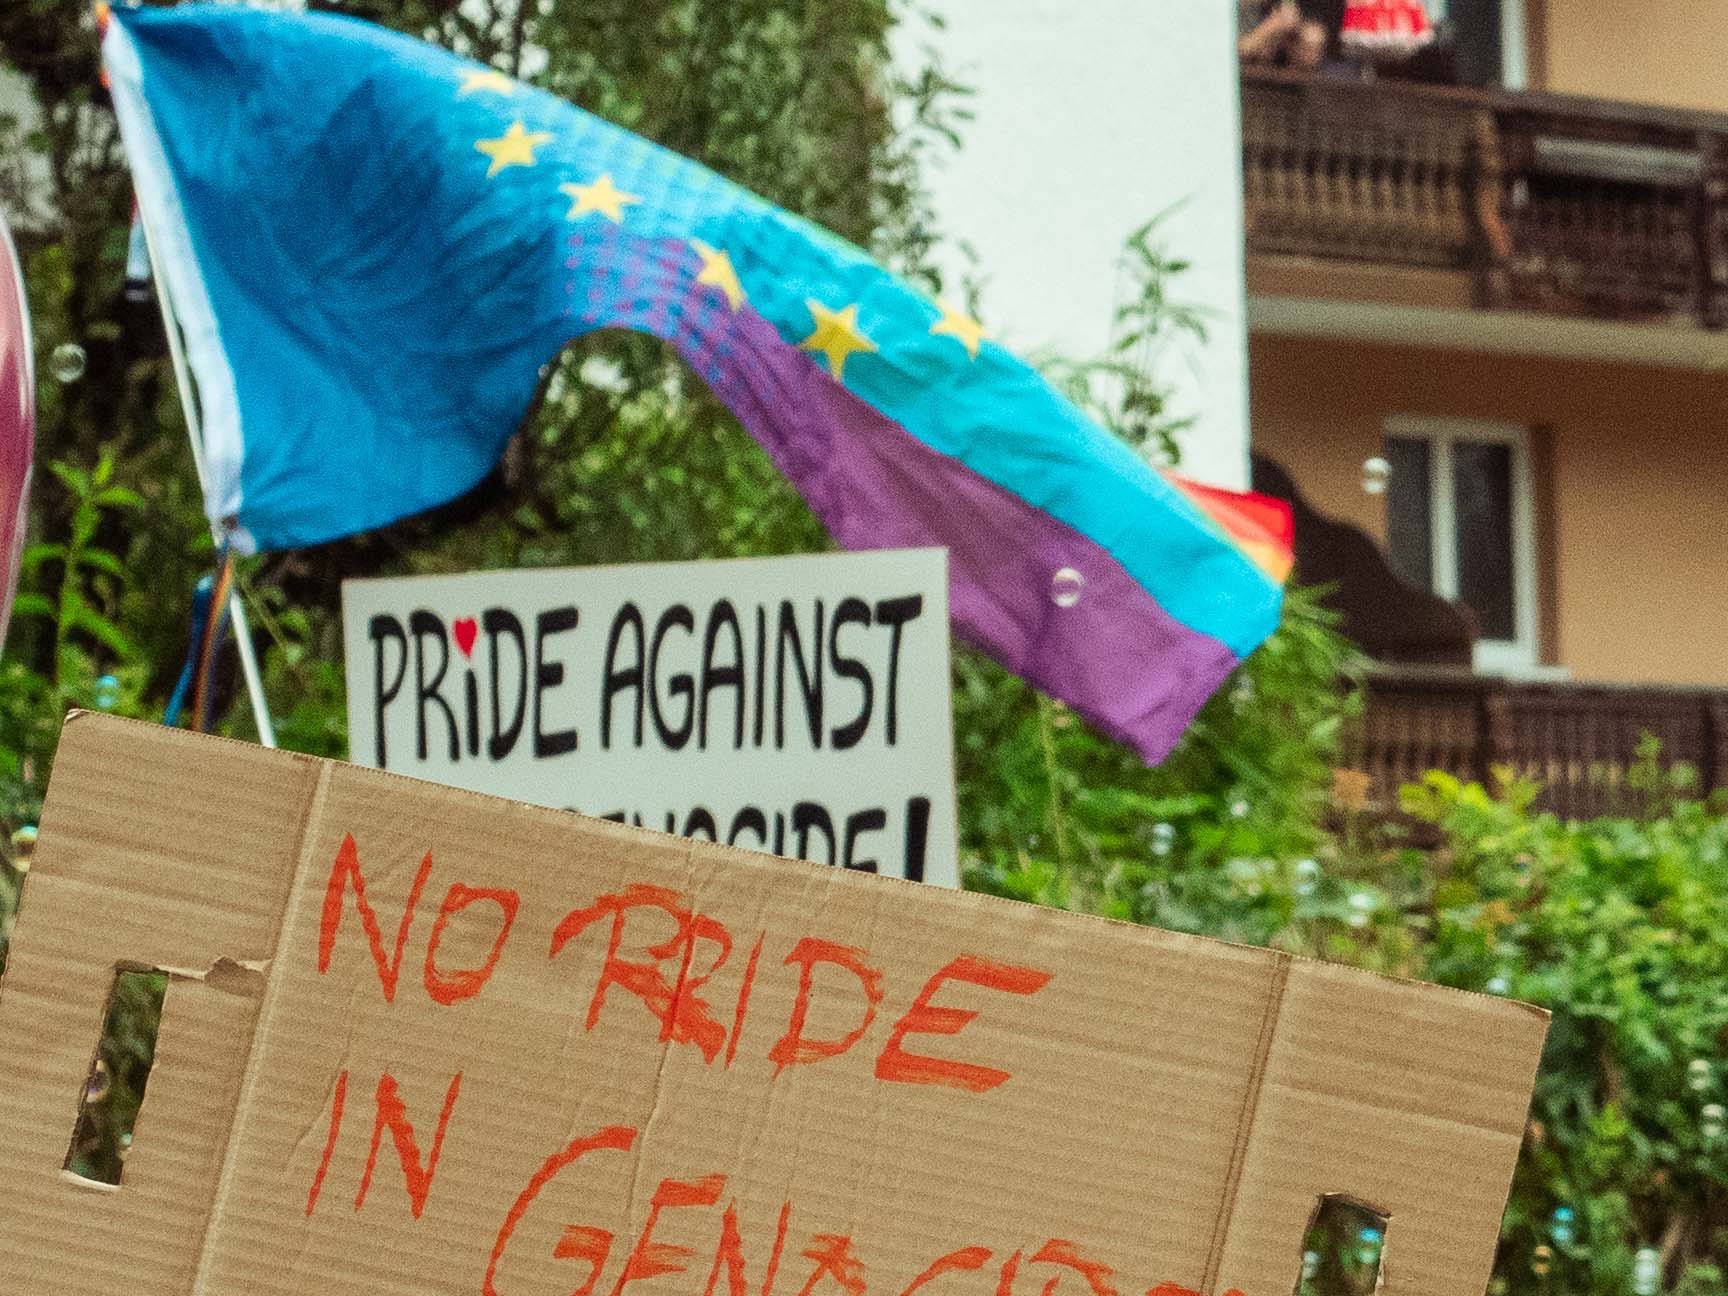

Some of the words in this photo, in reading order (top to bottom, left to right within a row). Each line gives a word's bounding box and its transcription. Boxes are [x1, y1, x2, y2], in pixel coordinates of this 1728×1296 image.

[600, 594, 924, 750] AGAINST
[316, 831, 520, 1006] NO
[306, 1069, 463, 1219] IN
